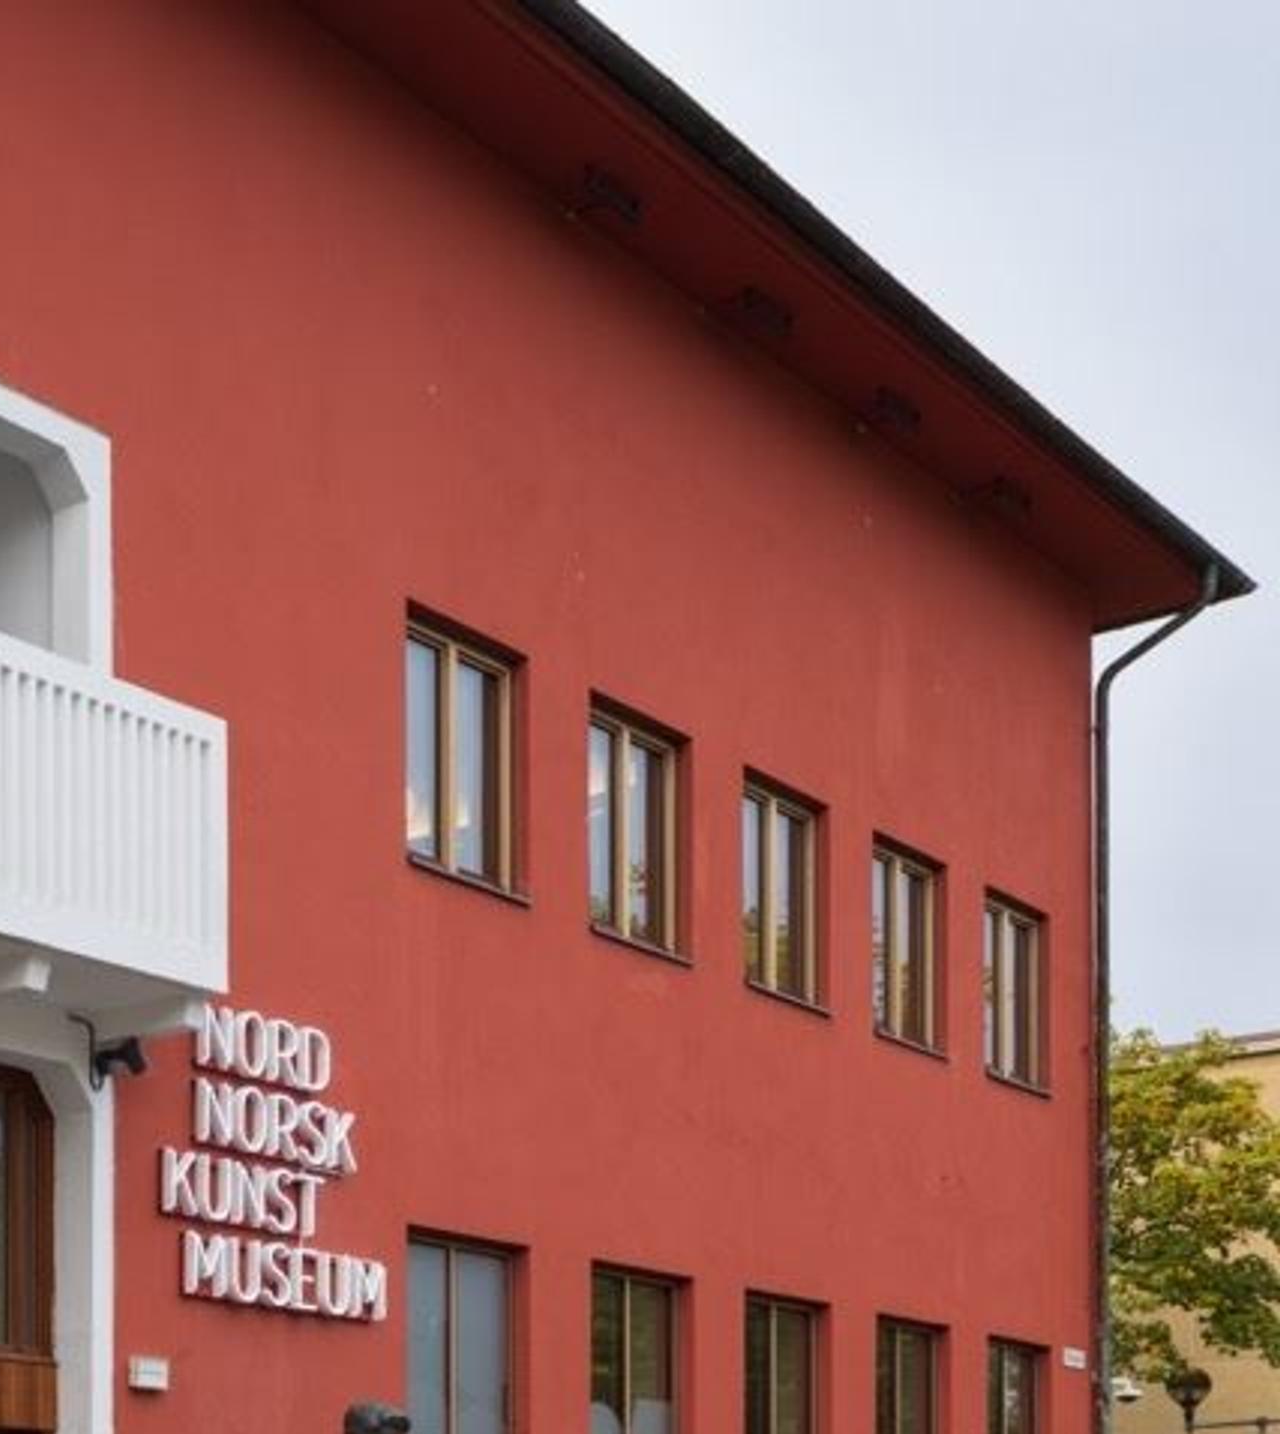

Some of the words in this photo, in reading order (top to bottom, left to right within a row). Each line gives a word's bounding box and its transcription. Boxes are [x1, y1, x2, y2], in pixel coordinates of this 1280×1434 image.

[196, 1005, 331, 1093] NORD
[195, 1079, 358, 1175] NORSK
[160, 1147, 326, 1238] KUNST
[183, 1230, 388, 1321] MUSEUM
